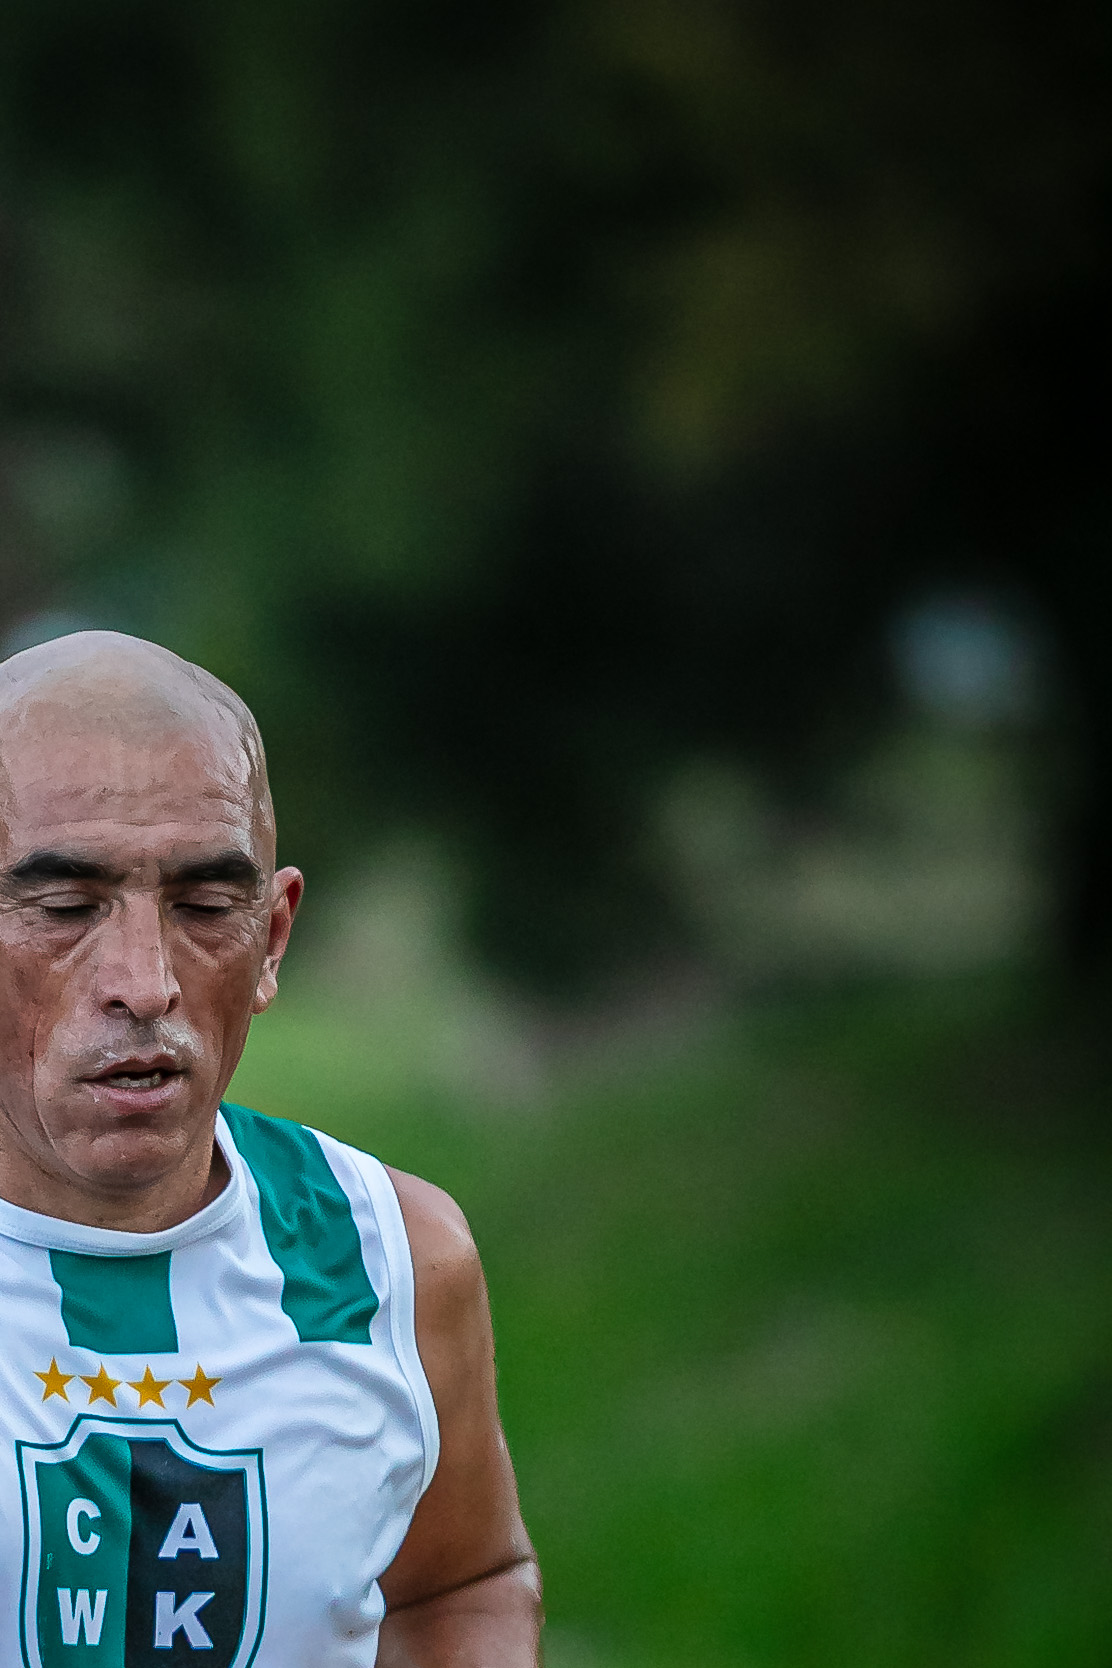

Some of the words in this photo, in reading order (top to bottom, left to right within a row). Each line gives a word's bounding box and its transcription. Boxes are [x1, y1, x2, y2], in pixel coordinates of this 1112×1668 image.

[65, 1497, 102, 1556] C
[157, 1502, 220, 1560] A
[56, 1587, 109, 1647] W
[152, 1591, 216, 1650] K
